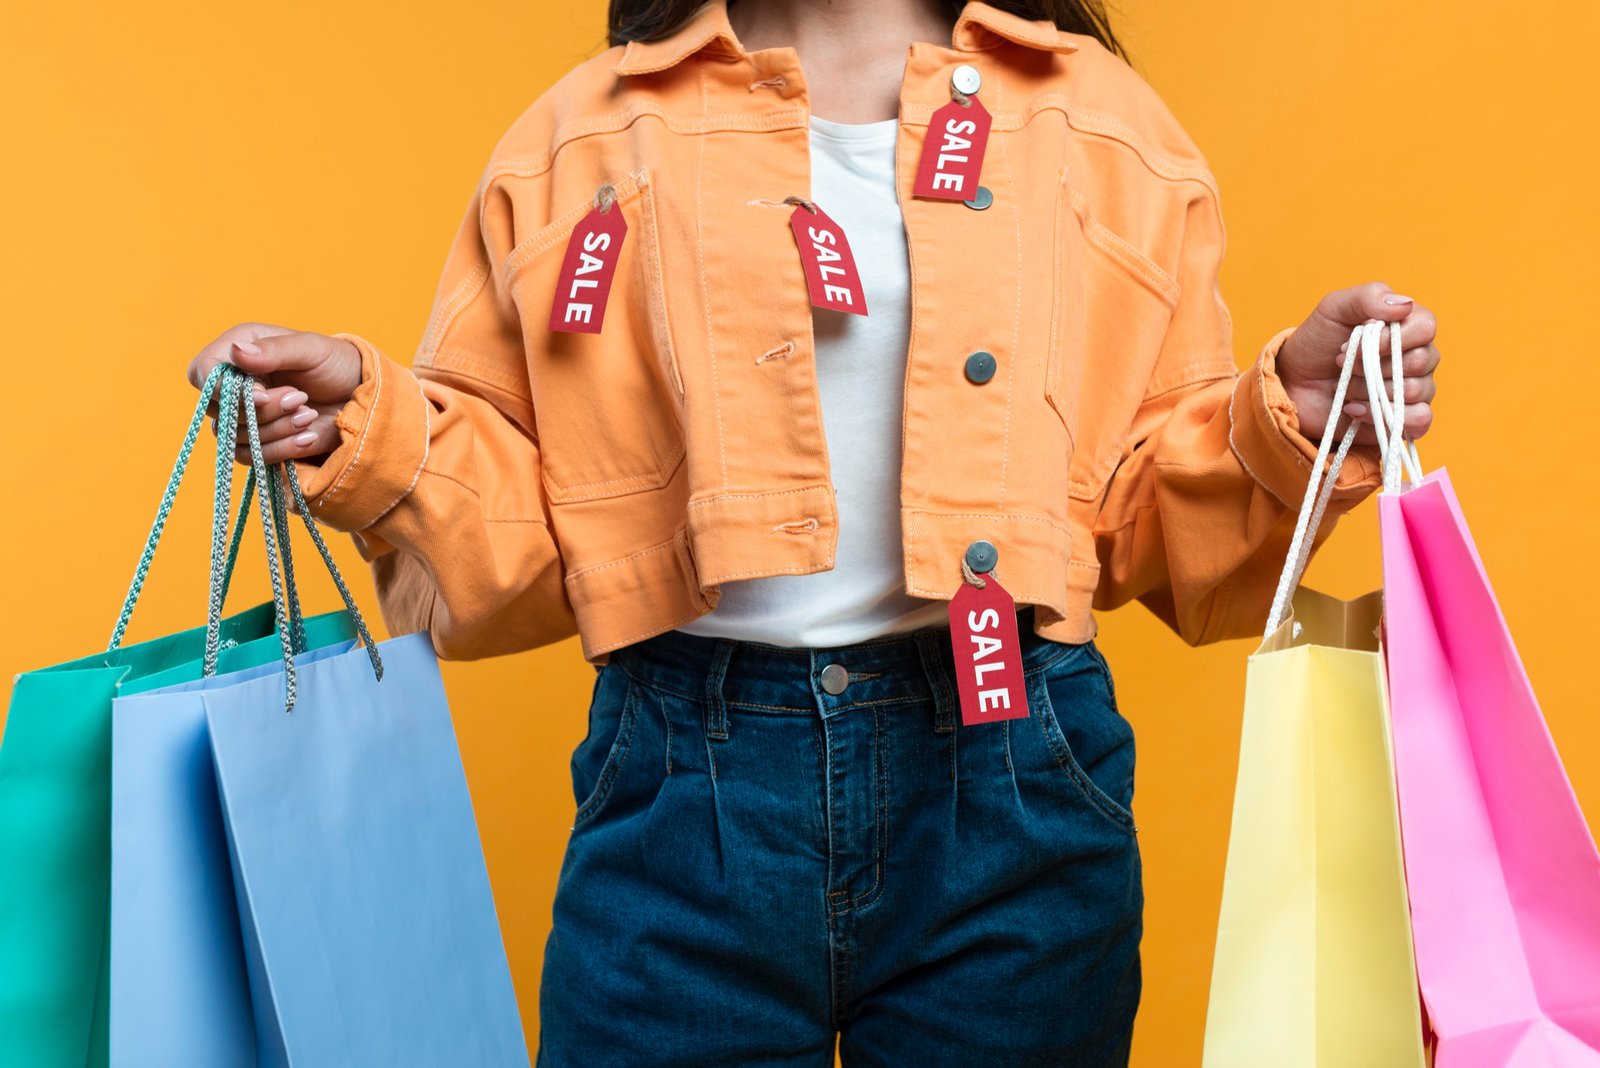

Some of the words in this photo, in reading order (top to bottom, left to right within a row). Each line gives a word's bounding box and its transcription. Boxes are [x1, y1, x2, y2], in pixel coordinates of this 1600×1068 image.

[932, 119, 976, 192] SALE
[564, 231, 611, 323] SALE
[808, 226, 853, 305] SALE
[968, 608, 1010, 712] SALE
